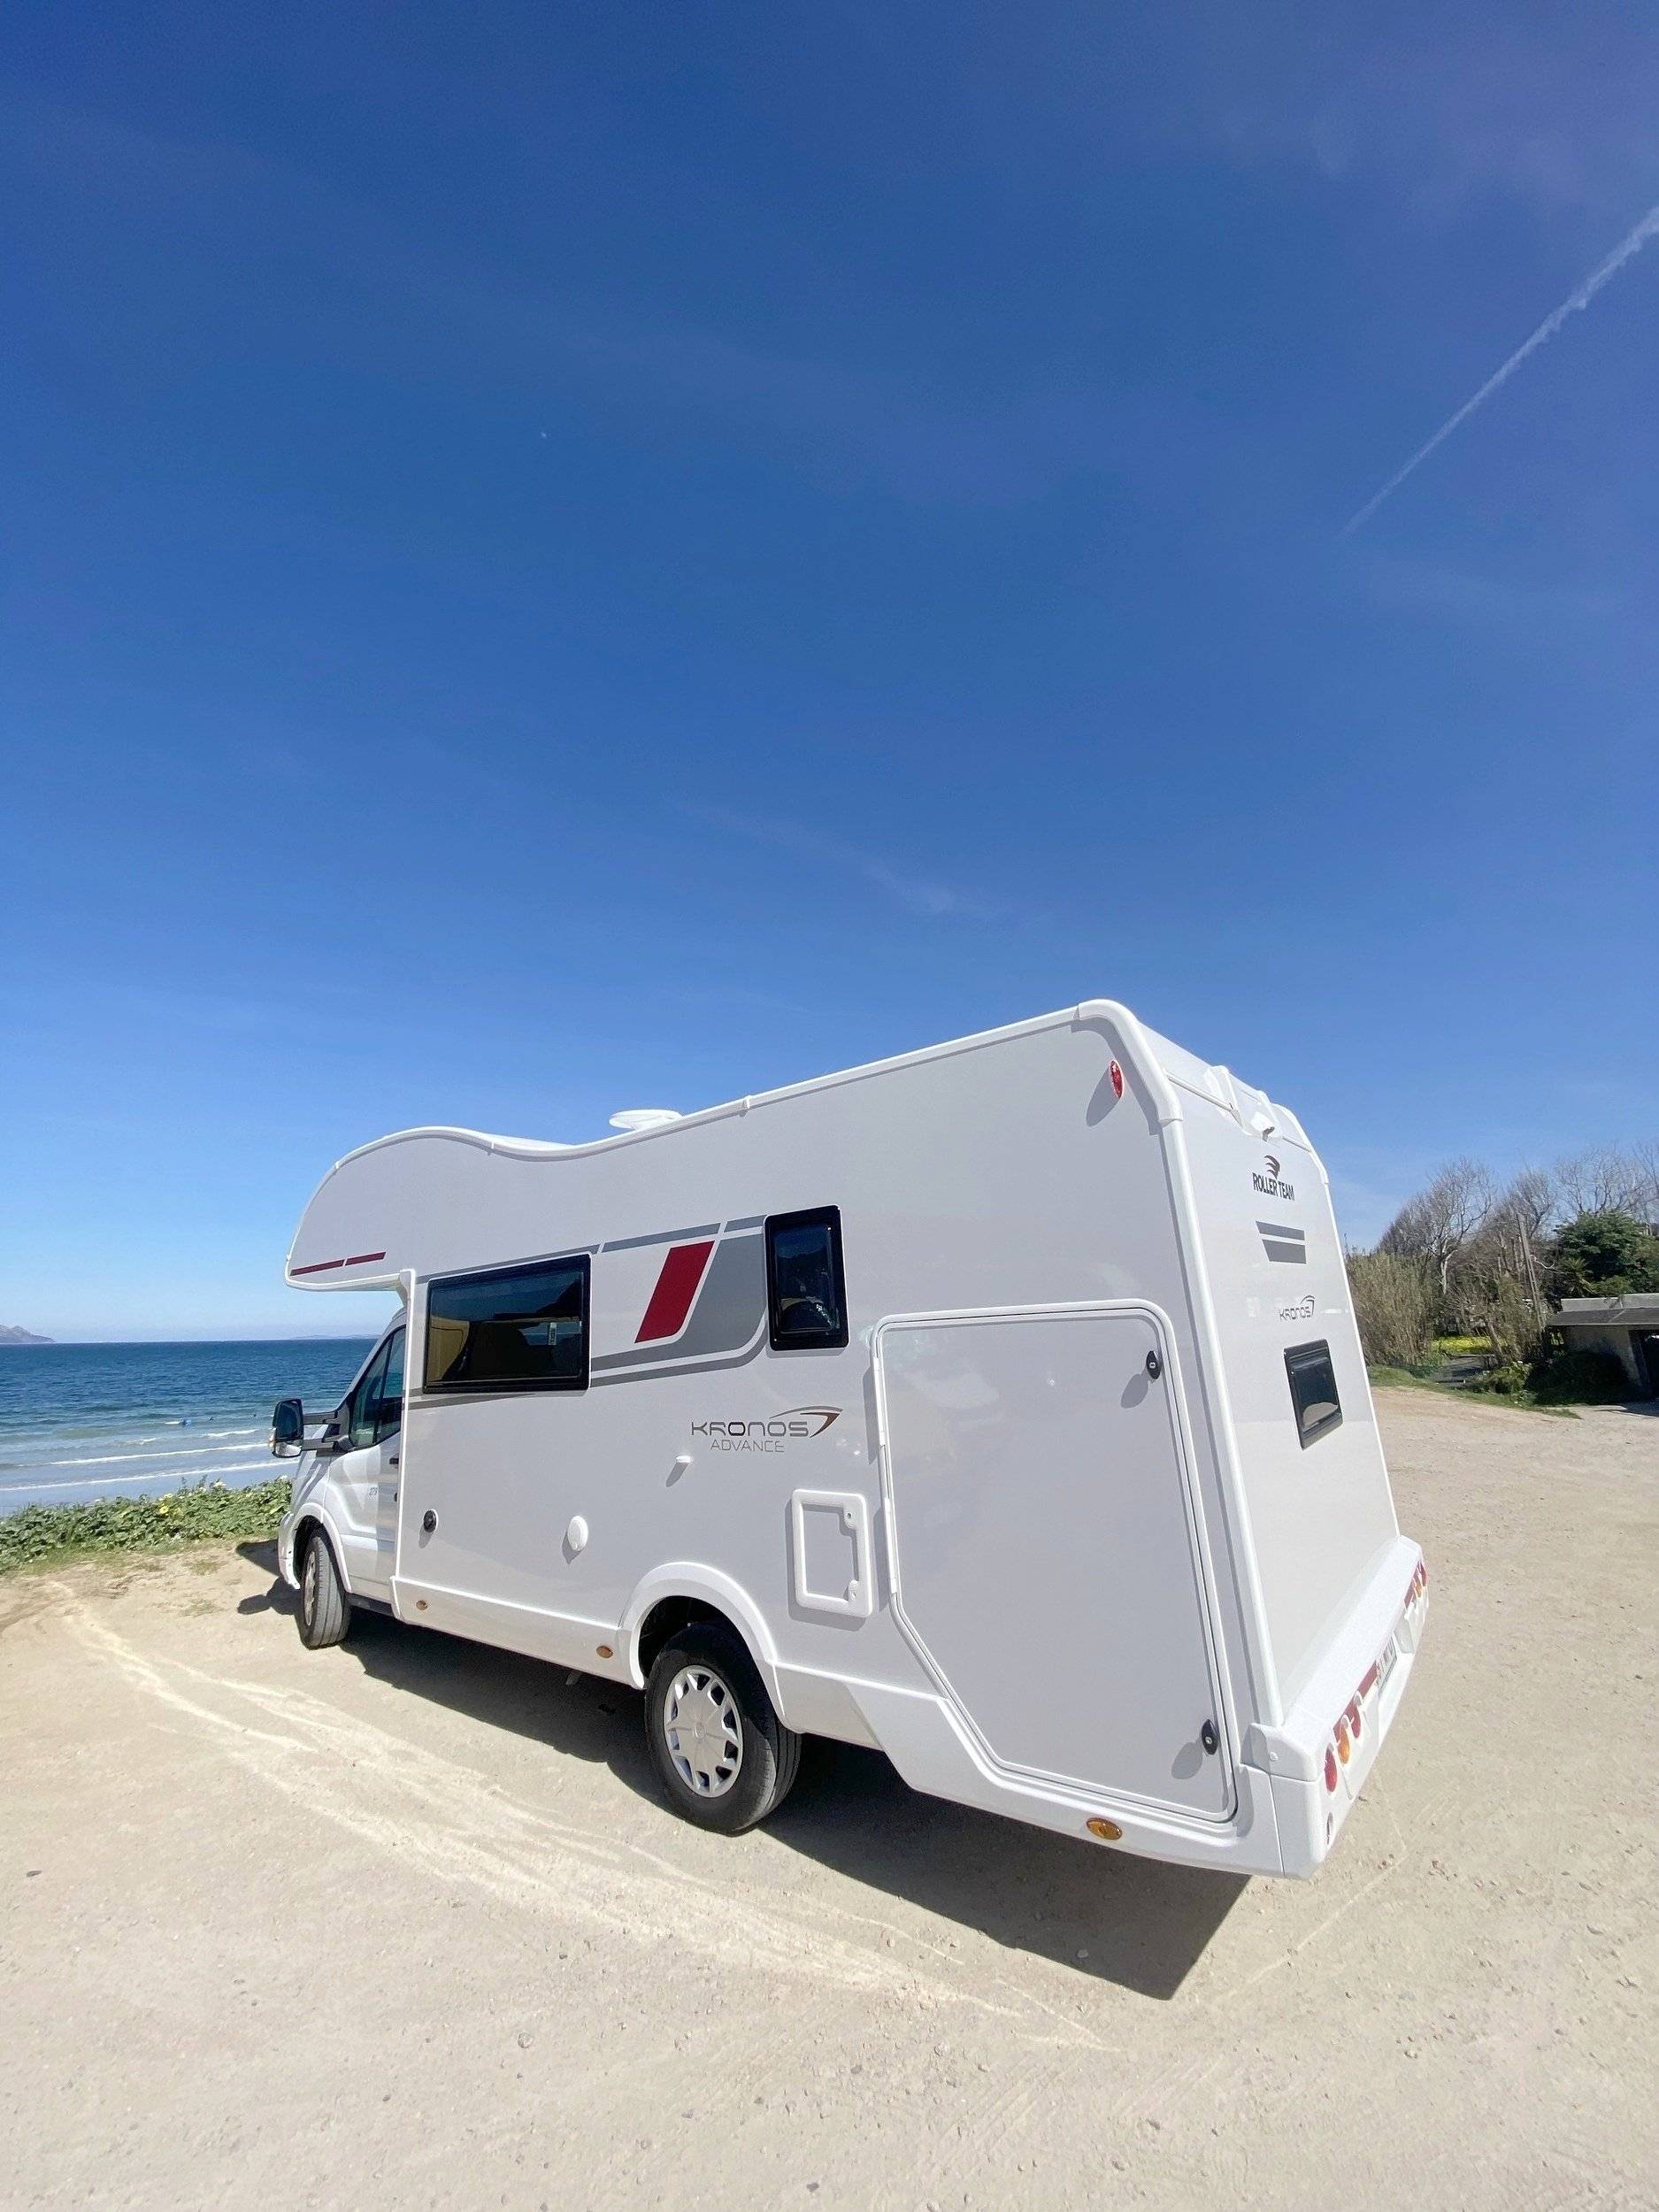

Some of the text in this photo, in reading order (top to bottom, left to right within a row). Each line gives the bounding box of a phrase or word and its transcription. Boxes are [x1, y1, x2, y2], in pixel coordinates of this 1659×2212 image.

[1252, 1172, 1294, 1201] ROLLER TEAM
[691, 1421, 809, 1437] KRONOS
[710, 1440, 785, 1453] ADVANCE
